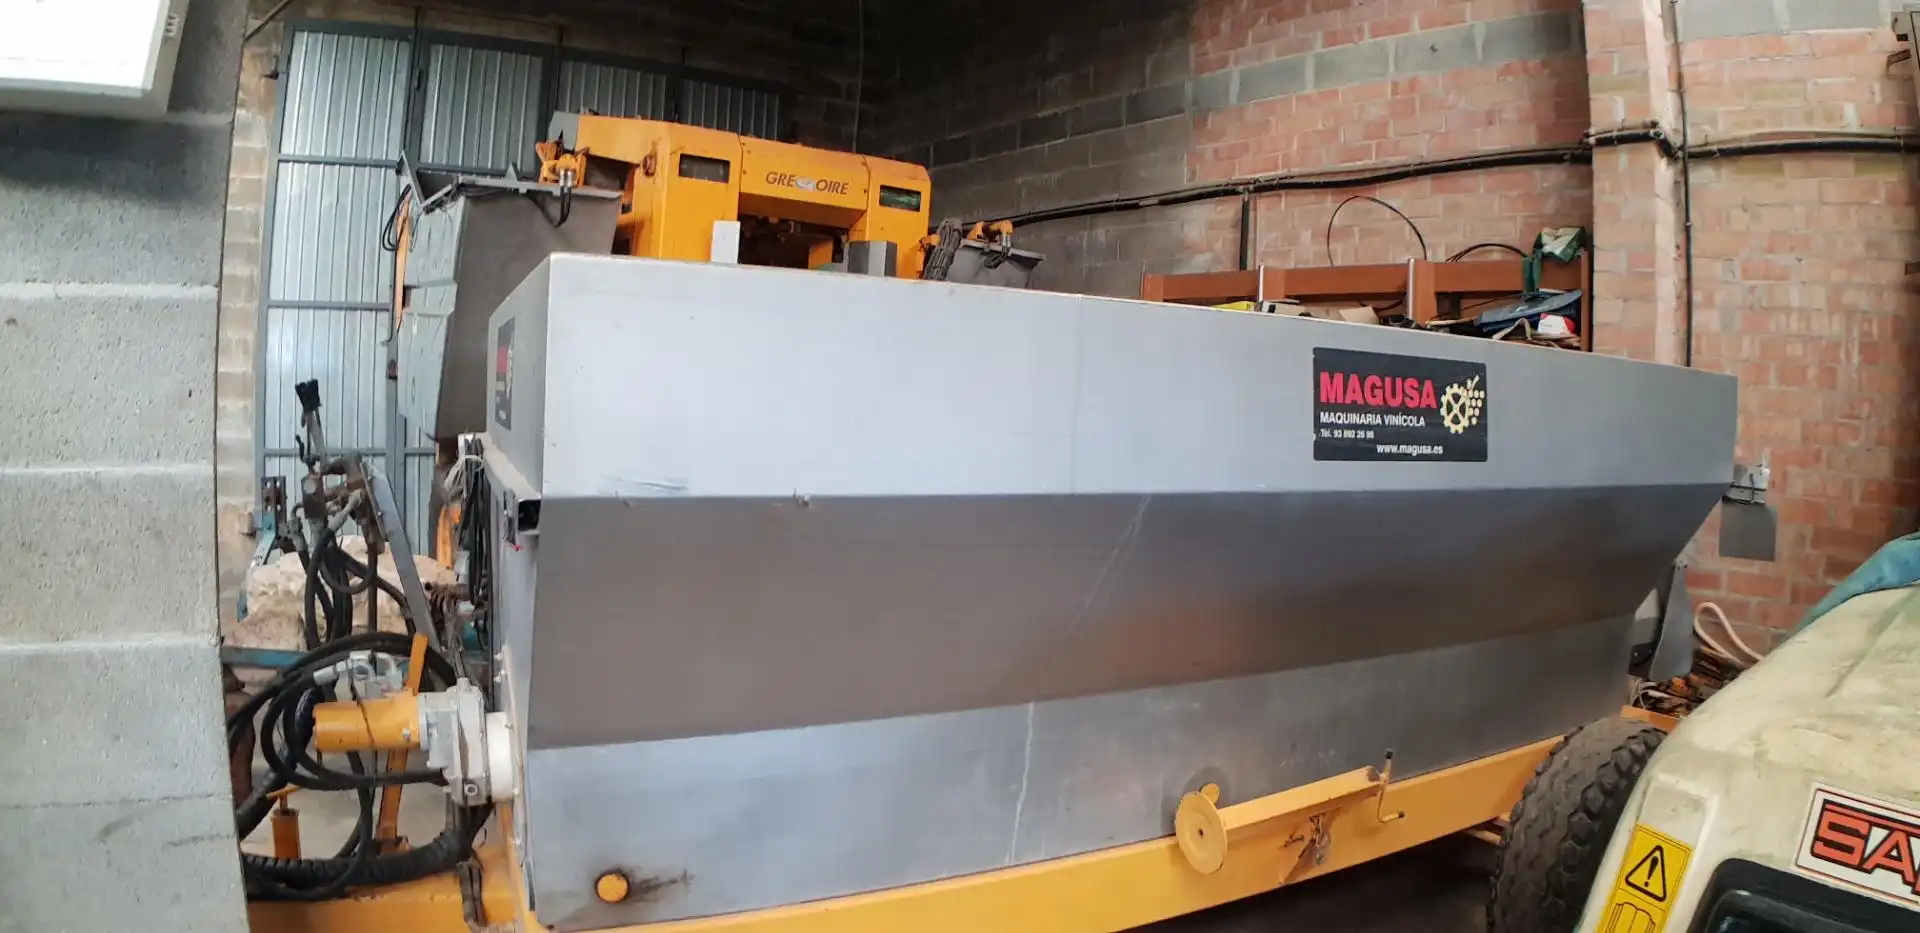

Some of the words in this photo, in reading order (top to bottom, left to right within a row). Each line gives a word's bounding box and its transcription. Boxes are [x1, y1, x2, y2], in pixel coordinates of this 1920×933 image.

[766, 171, 849, 195] GREOIRE
[1320, 371, 1438, 409] MAGUSA
[1320, 412, 1382, 426] MAQUINARIA
[1384, 411, 1426, 427] VINÍCOLA
[1333, 429, 1342, 438] 93
[1376, 443, 1443, 456] www.magusa.es
